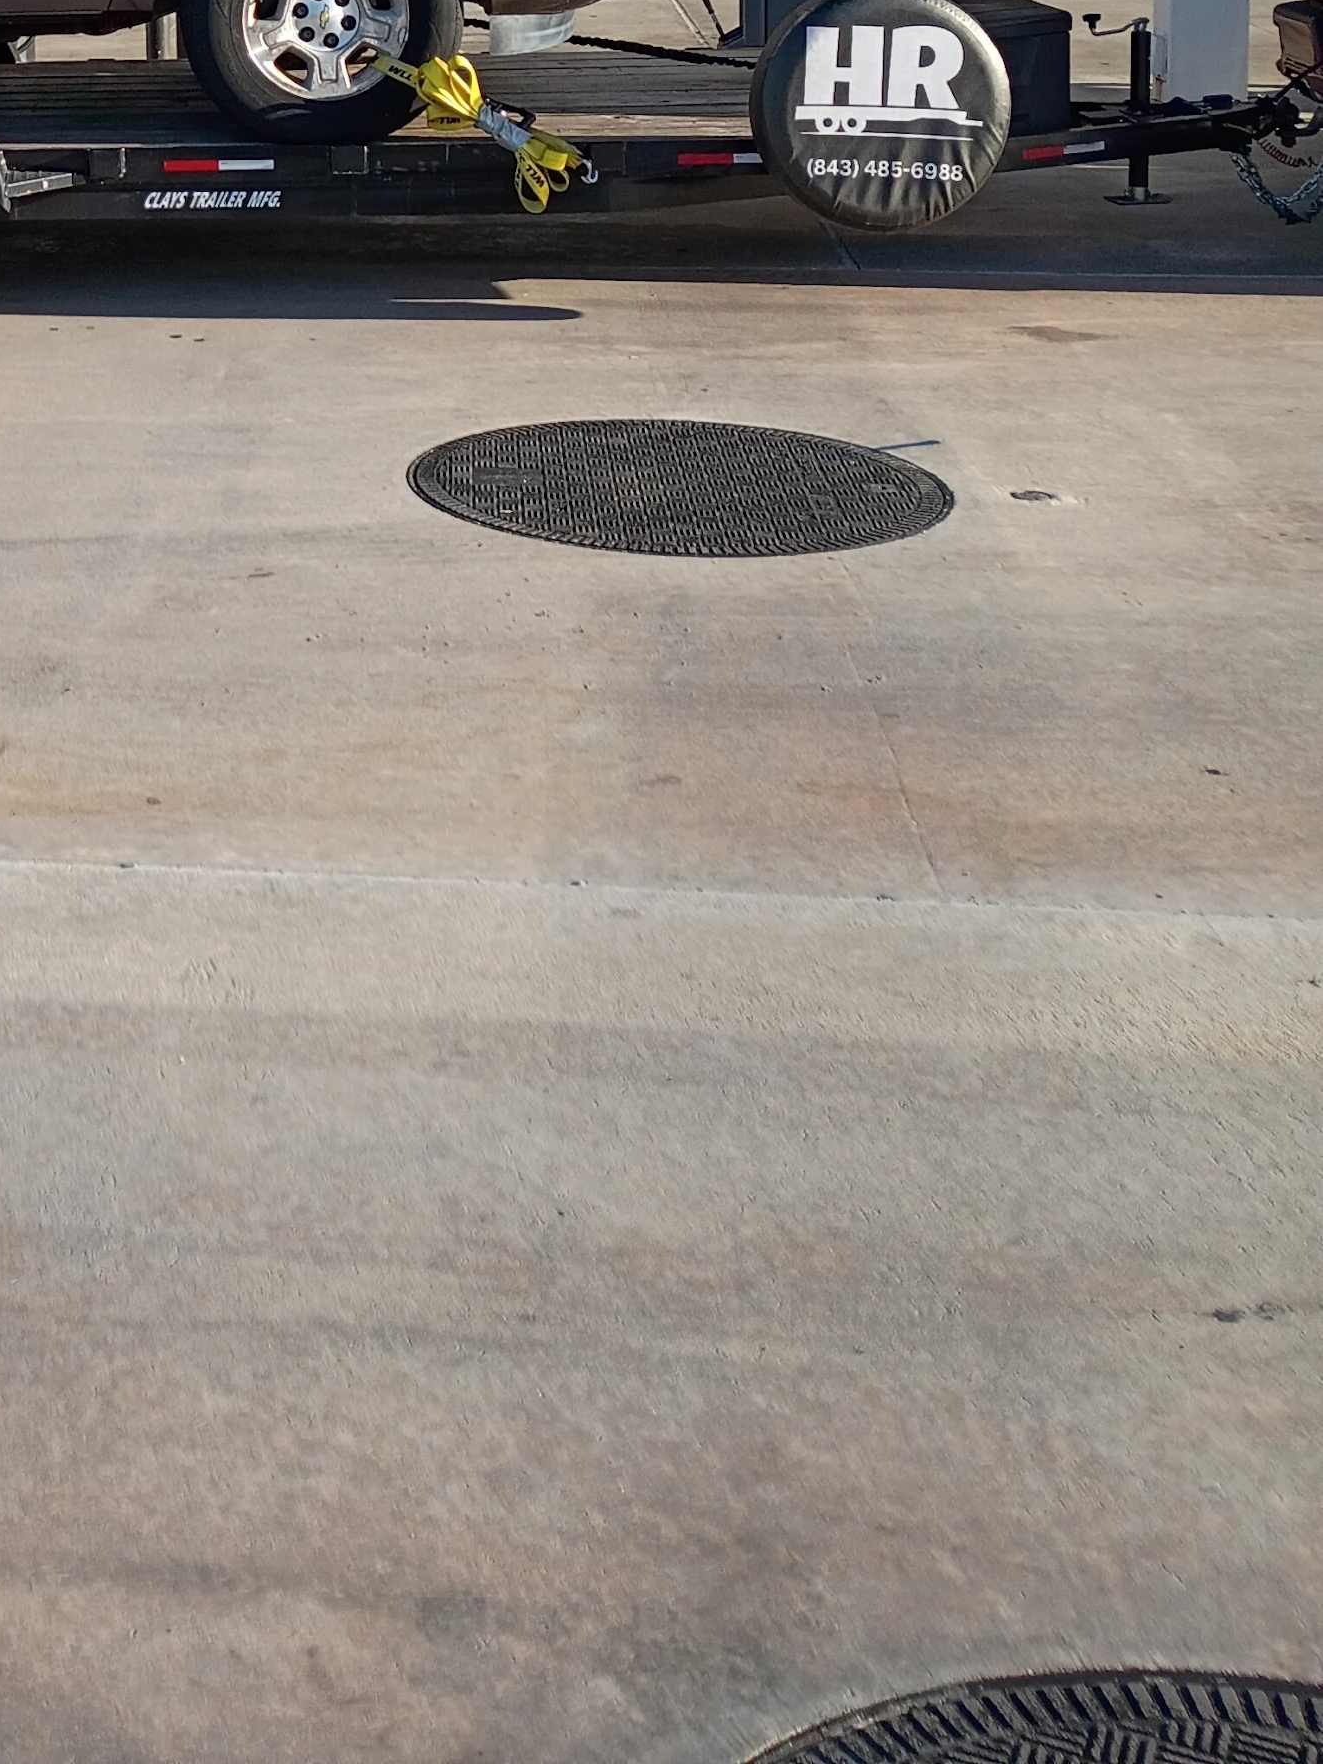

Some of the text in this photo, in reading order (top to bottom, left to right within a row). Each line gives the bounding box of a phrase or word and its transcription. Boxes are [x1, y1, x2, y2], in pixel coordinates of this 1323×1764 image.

[803, 25, 965, 109] HR
[807, 157, 964, 182] (843) 485-6988
[143, 190, 282, 209] CLAYS TRAILER MFG.
